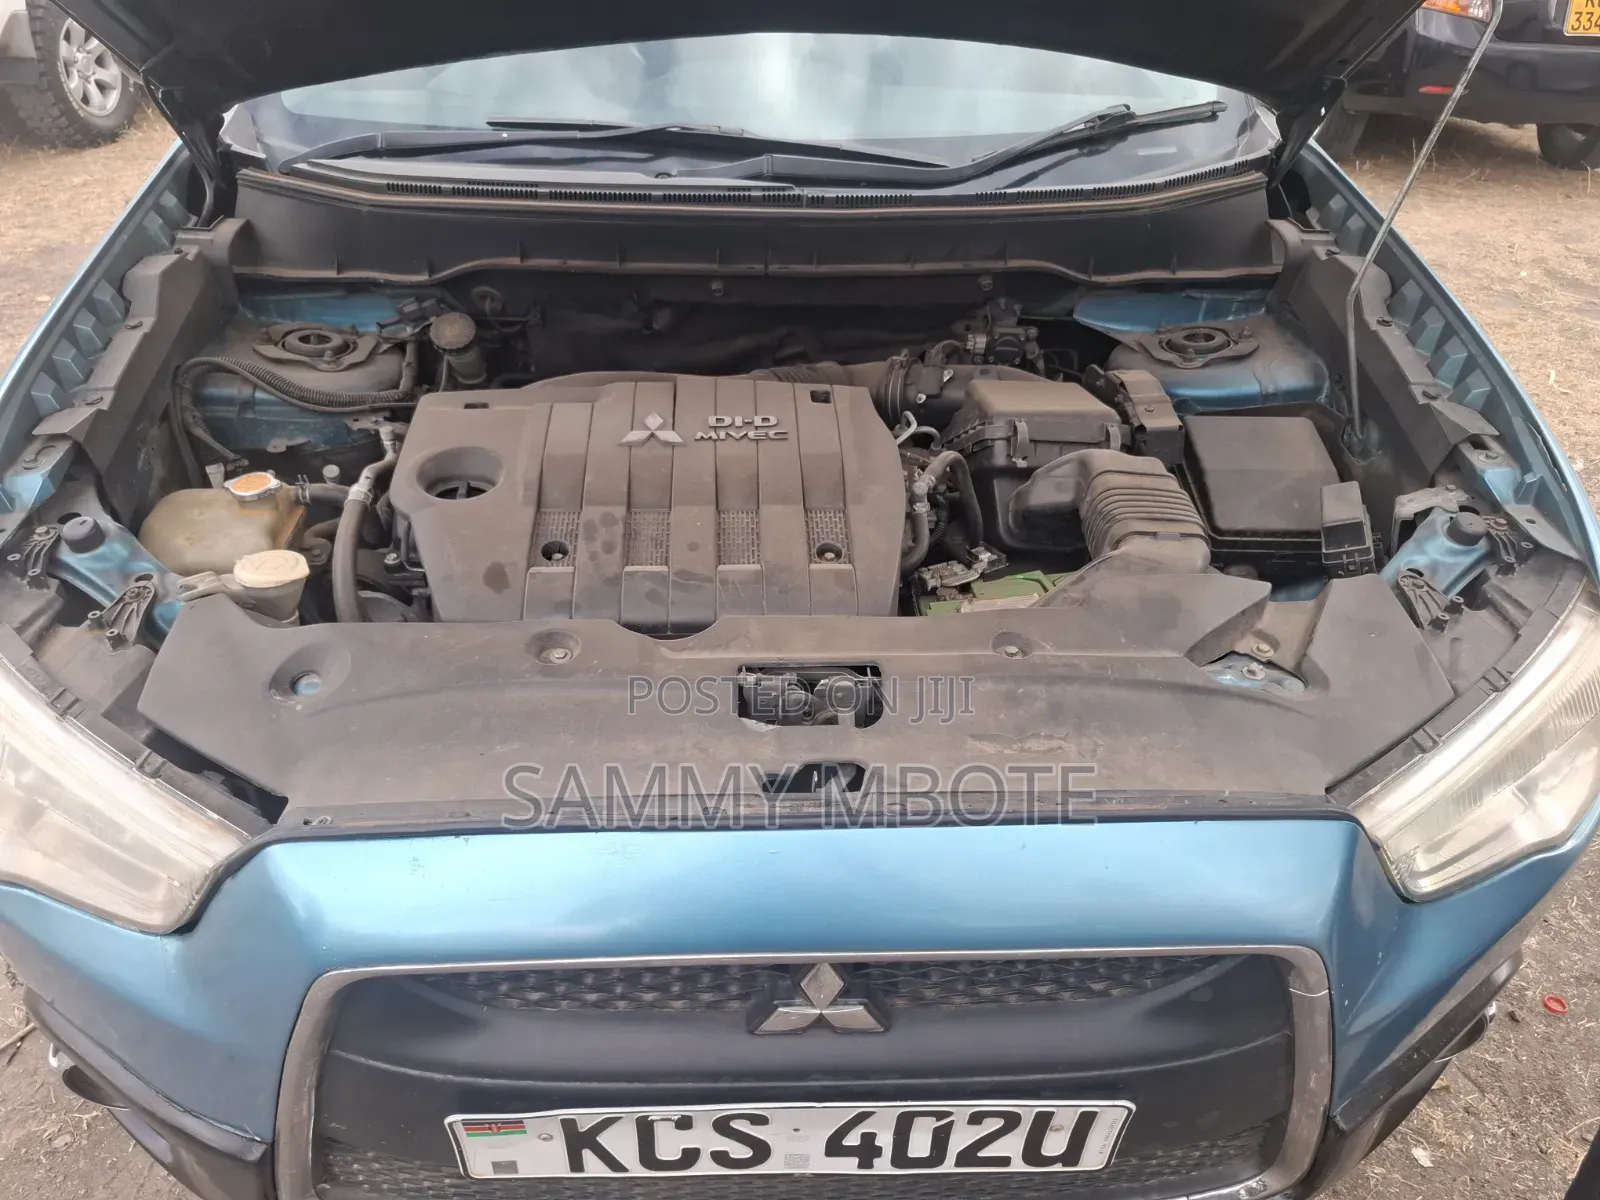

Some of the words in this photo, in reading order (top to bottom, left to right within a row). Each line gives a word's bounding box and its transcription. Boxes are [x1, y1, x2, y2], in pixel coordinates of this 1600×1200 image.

[708, 415, 778, 428] DI-D
[694, 430, 788, 441] MIVEC
[559, 1112, 772, 1173] KCS
[824, 1109, 1099, 1170] 402U
